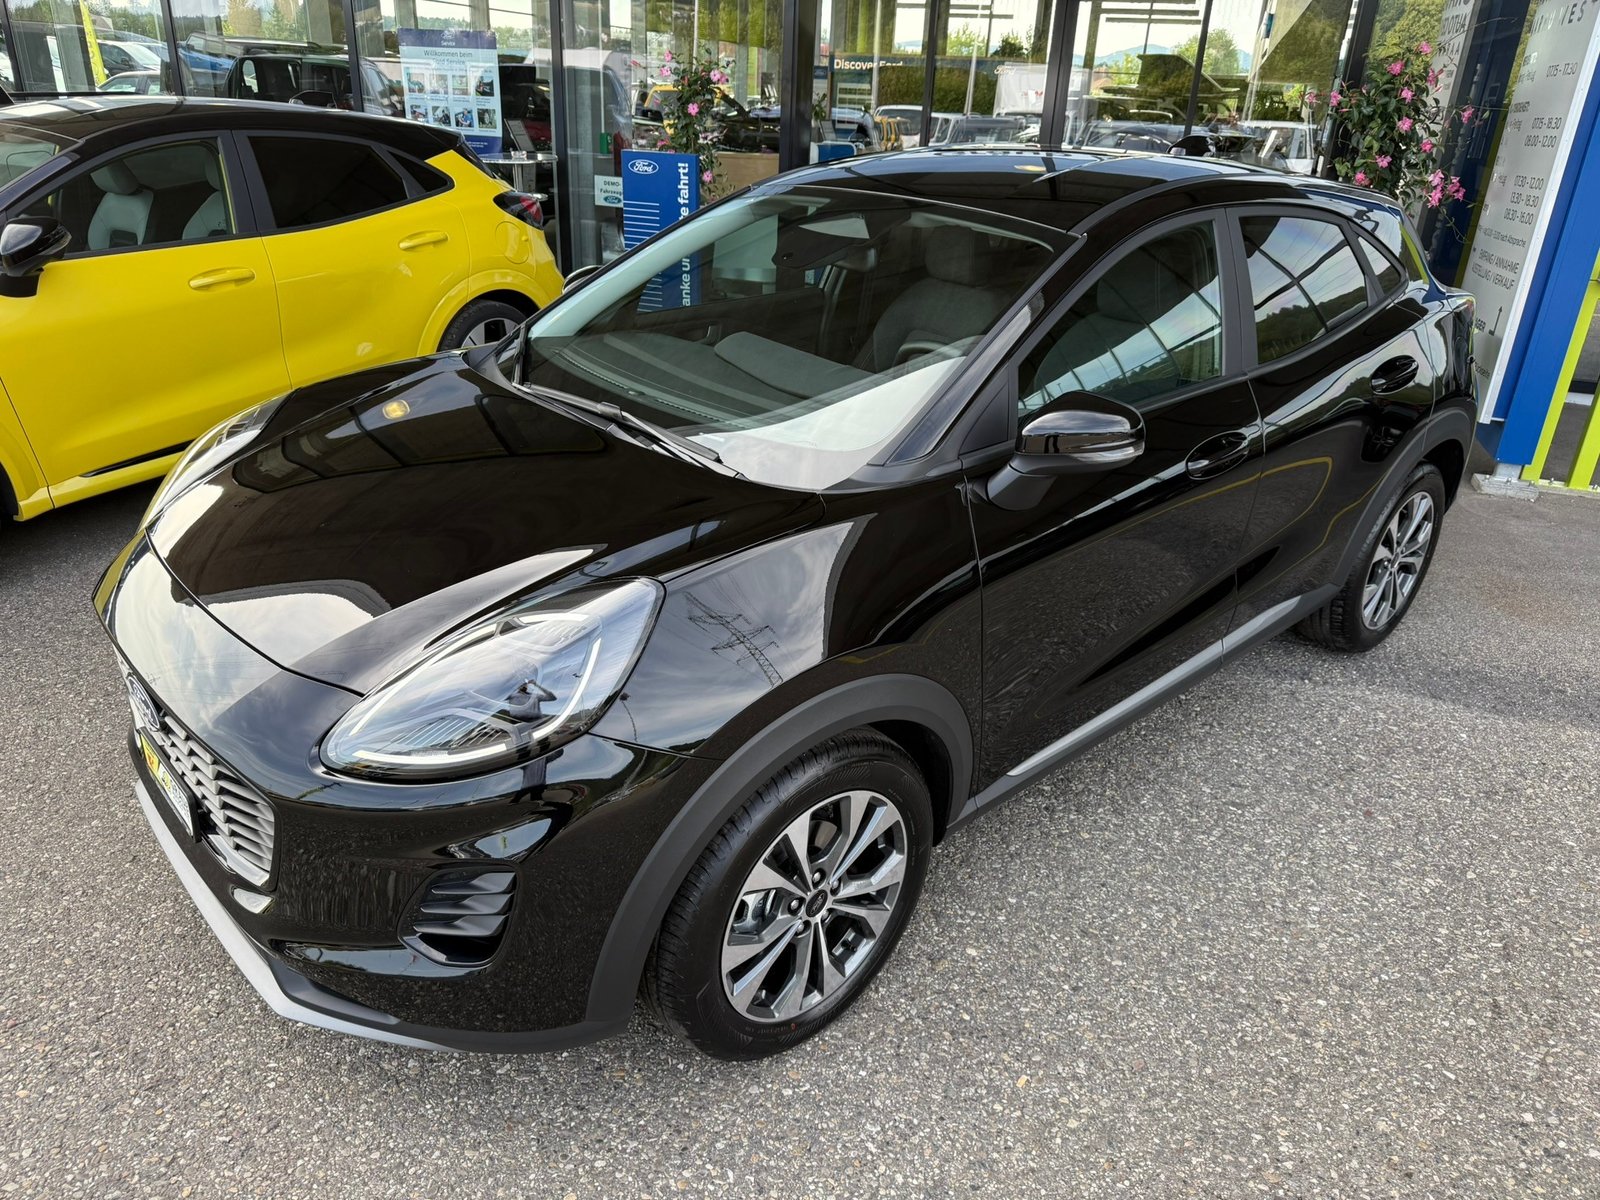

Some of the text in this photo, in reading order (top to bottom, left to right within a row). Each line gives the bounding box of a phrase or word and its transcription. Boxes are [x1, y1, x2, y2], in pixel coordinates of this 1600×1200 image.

[423, 49, 459, 58] Willkommen
[834, 58, 878, 70] Discover
[634, 161, 654, 172] Ford
[677, 162, 689, 205] fahrt!
[680, 273, 691, 307] anke
